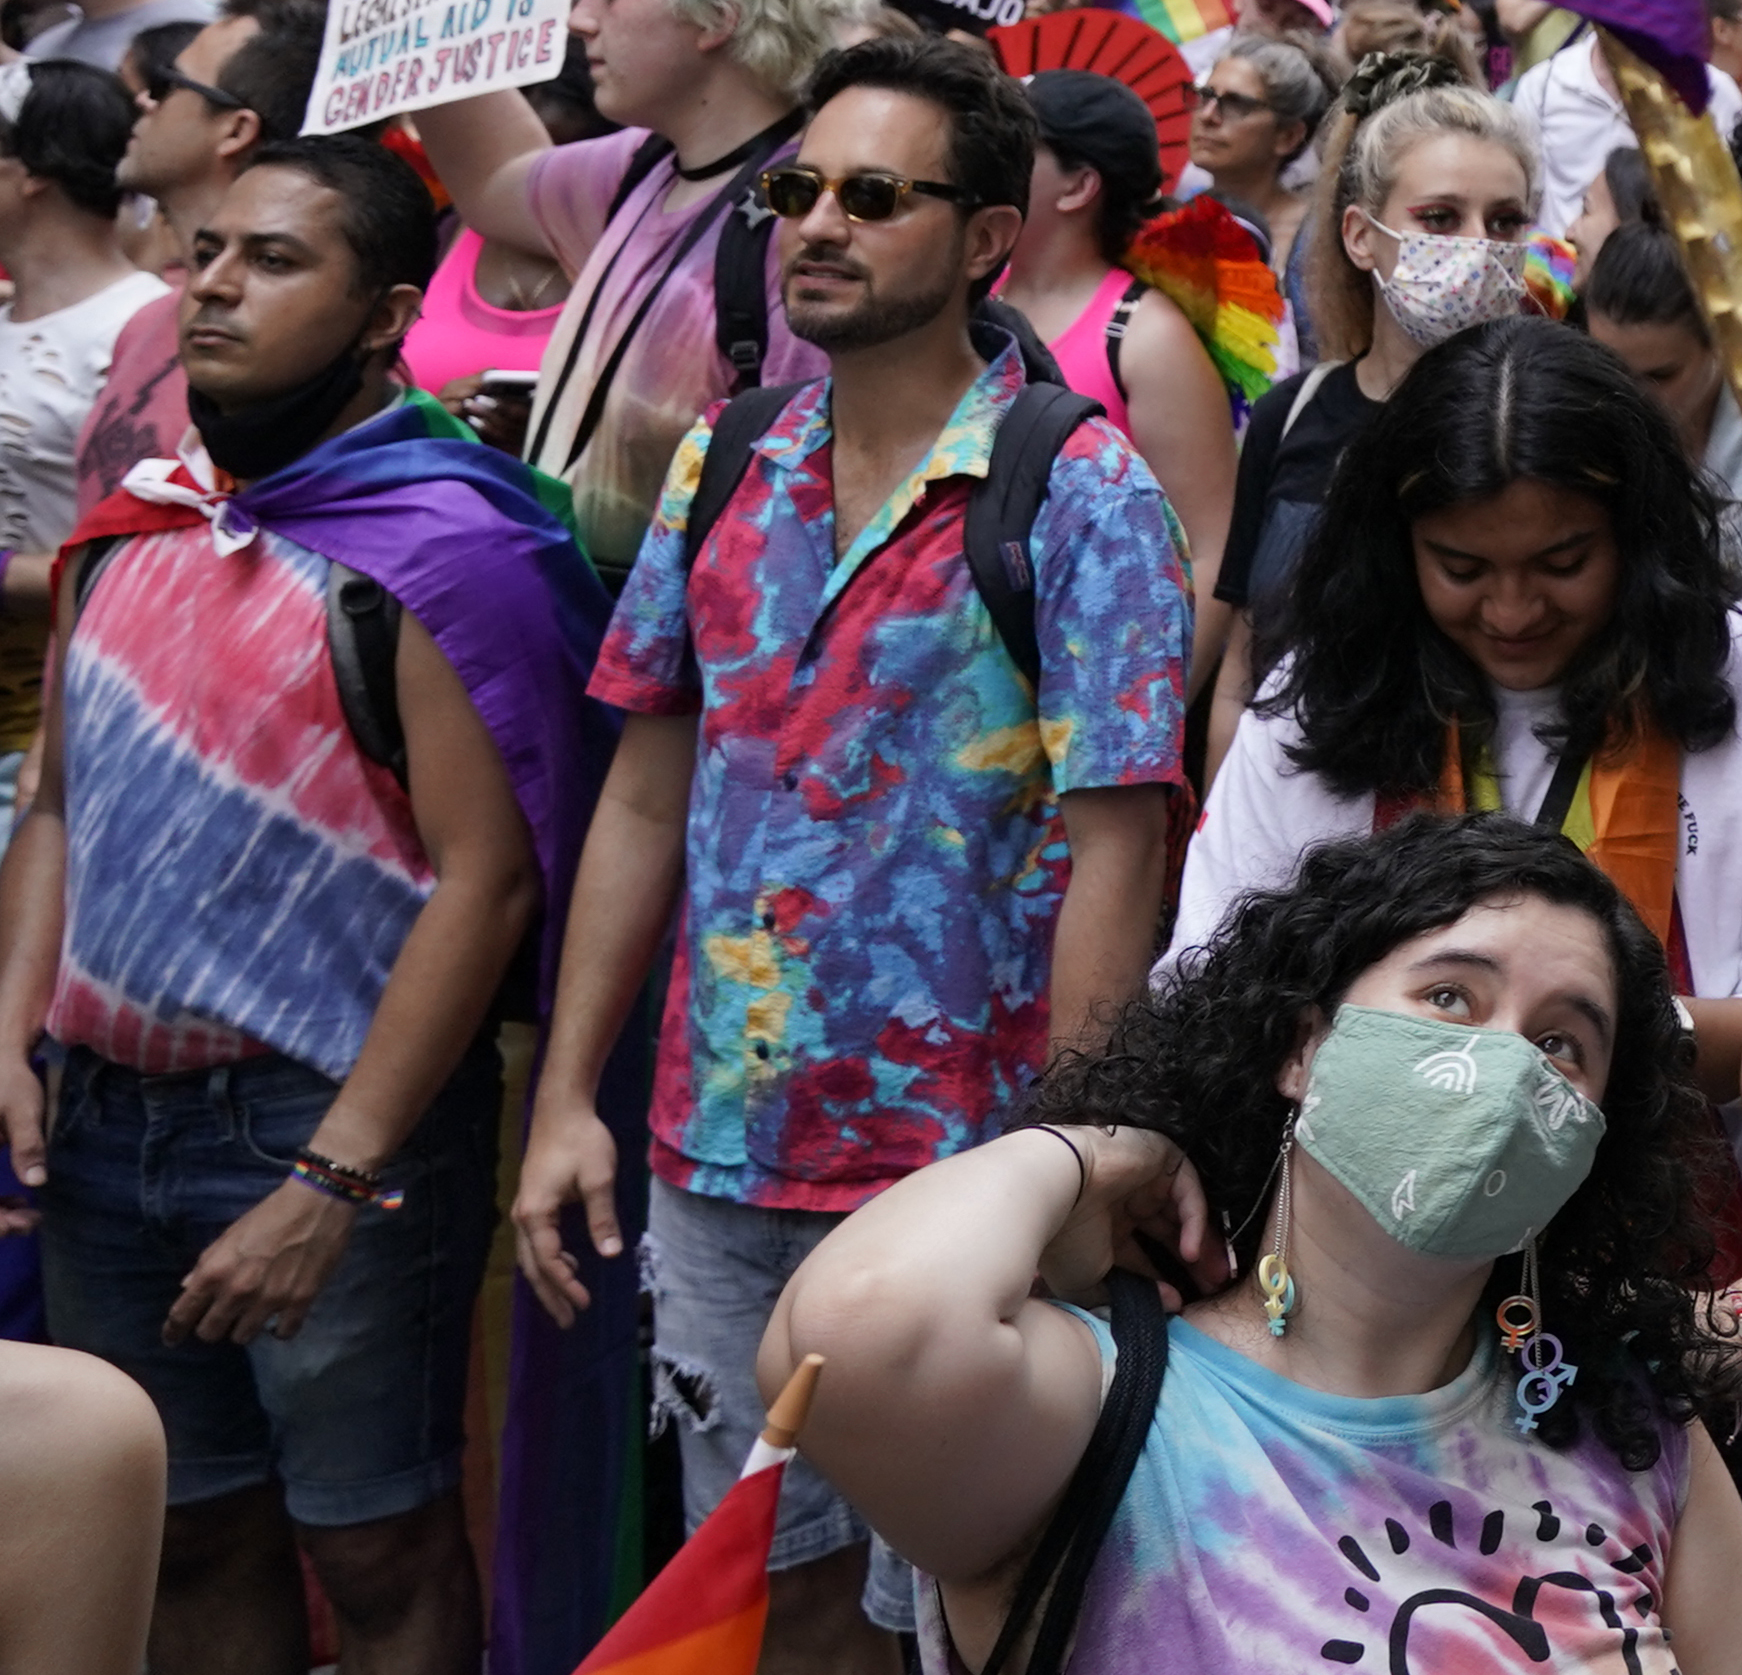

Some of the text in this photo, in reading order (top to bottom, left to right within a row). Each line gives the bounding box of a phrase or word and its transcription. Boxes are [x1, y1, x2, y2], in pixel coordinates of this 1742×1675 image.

[325, 18, 556, 126] GENDER JUSTICE
[333, 17, 429, 81] MUTUAL
[1684, 812, 1699, 856] FUCK
